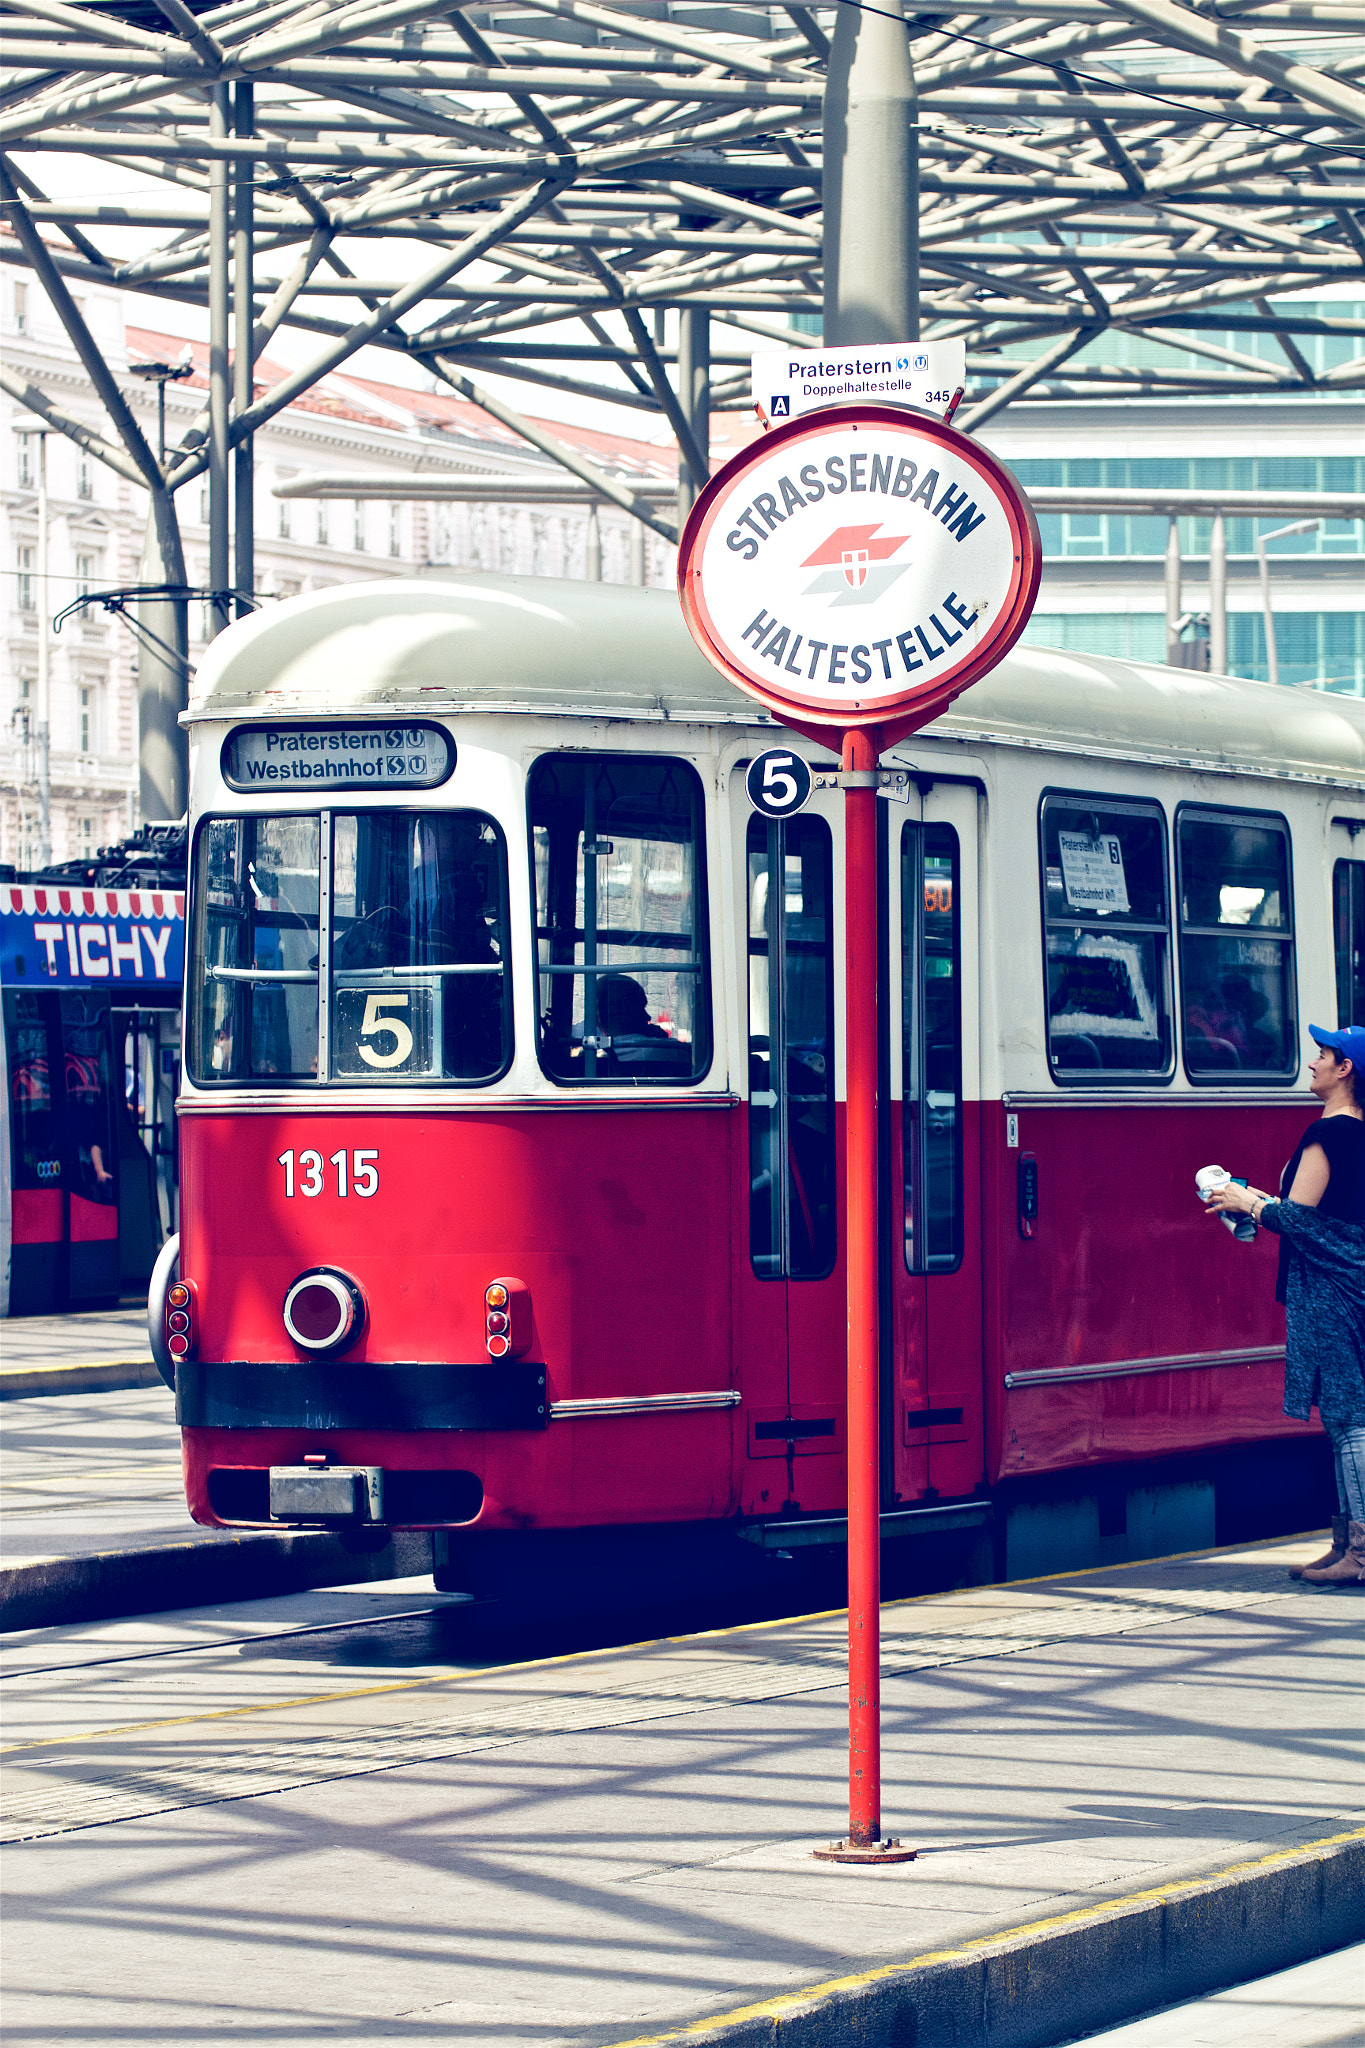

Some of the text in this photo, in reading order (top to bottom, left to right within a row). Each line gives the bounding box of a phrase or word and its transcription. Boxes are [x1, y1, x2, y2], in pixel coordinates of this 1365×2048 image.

[789, 359, 892, 378] Praterstern
[803, 379, 912, 397] Doppelhaltestelle
[925, 391, 950, 403] 345
[773, 397, 788, 415] A
[726, 453, 986, 561] STRASSENBAHN
[741, 591, 980, 684] HALTESTELLE
[266, 732, 382, 752] Praterstern
[246, 757, 384, 780] Westbahnhof
[761, 757, 798, 808] 5
[1069, 885, 1104, 901] Westbahnhof
[34, 922, 173, 979] TICHY
[358, 994, 413, 1069] 5
[277, 1149, 380, 1198] 1315
